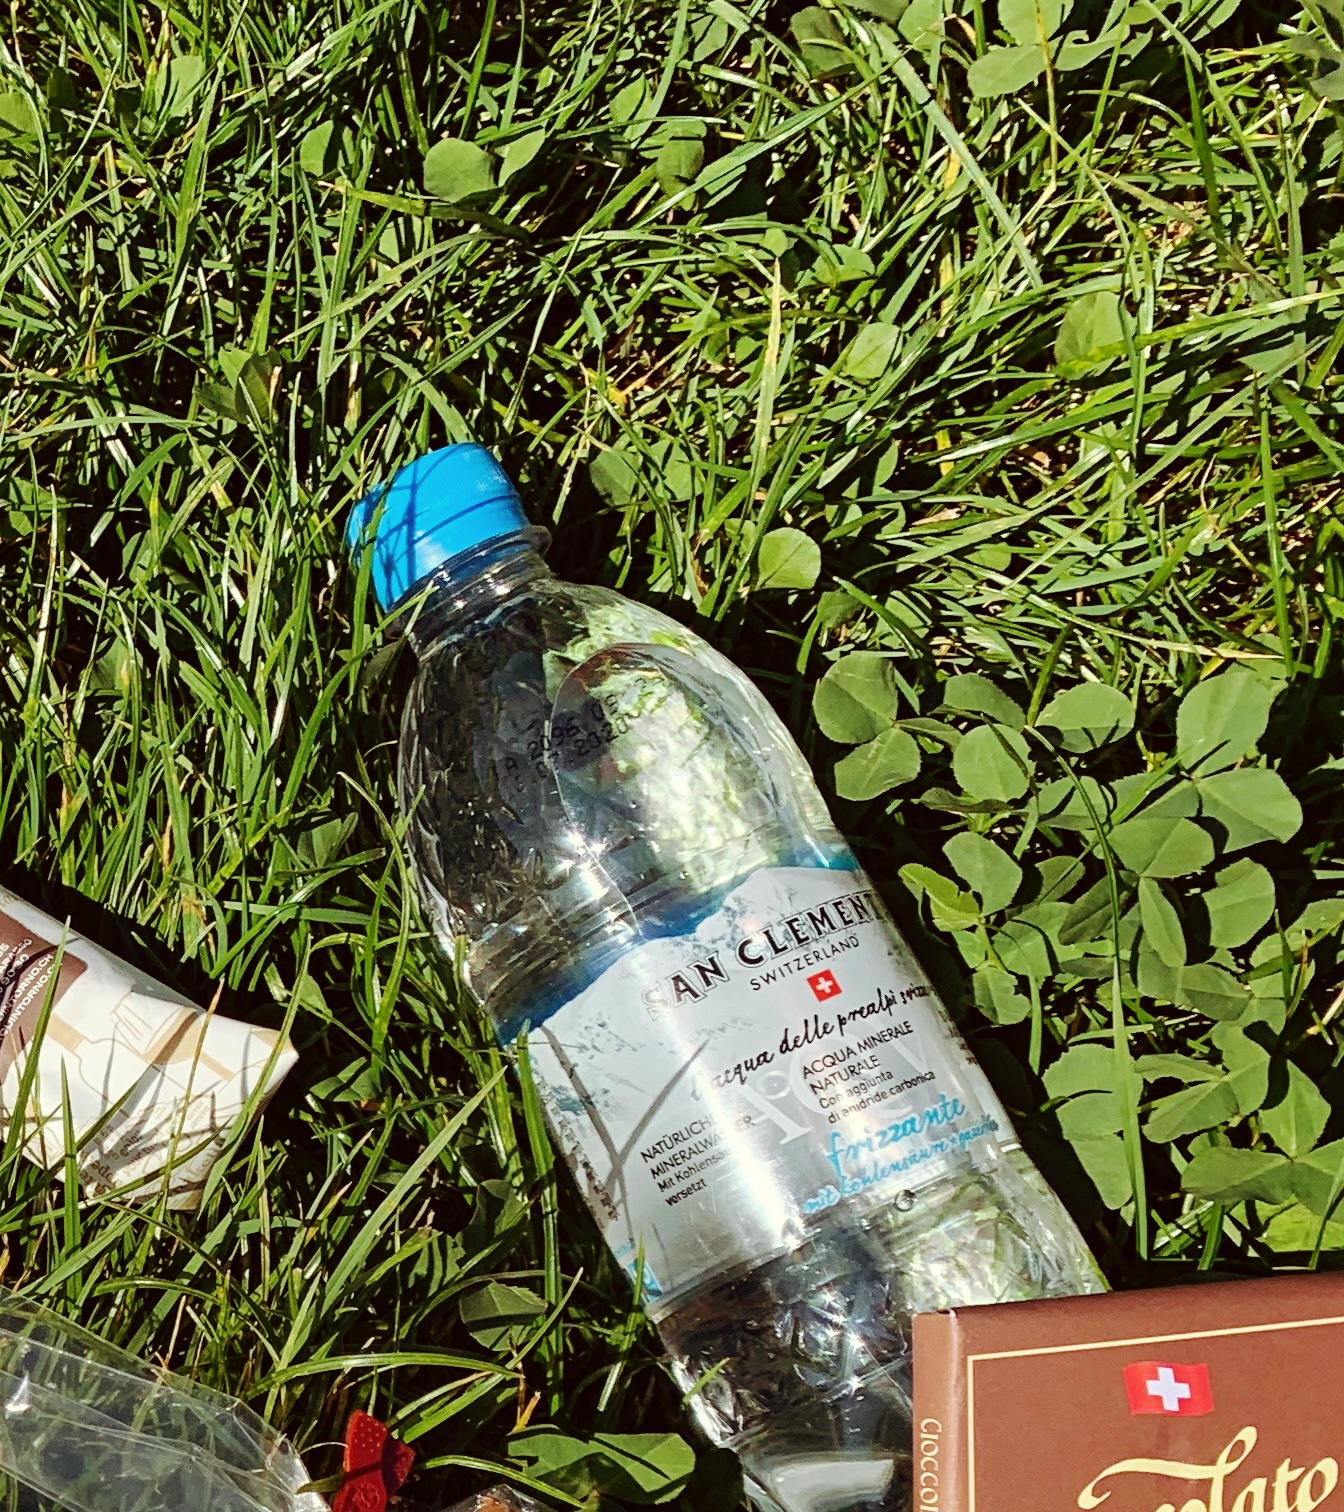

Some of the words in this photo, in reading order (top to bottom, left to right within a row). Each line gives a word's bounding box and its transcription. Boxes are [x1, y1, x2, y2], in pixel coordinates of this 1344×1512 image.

[641, 952, 730, 1022] SAN
[749, 935, 860, 991] SWITZERLAND
[779, 1014, 834, 1055] delle
[836, 987, 897, 1036] prealpi
[802, 1046, 856, 1079] ACQUA
[857, 1021, 914, 1052] MINERALE
[809, 1054, 881, 1095] NATURALE
[819, 1092, 844, 1110] Con
[846, 1069, 894, 1100] aggiunta
[827, 1111, 841, 1125] di
[843, 1092, 889, 1118] anidride
[889, 1069, 936, 1096] carbonica
[826, 1094, 965, 1177] frizzante
[657, 1178, 674, 1193] Mit
[665, 1178, 708, 1207] versetzt
[803, 1183, 837, 1213] mit
